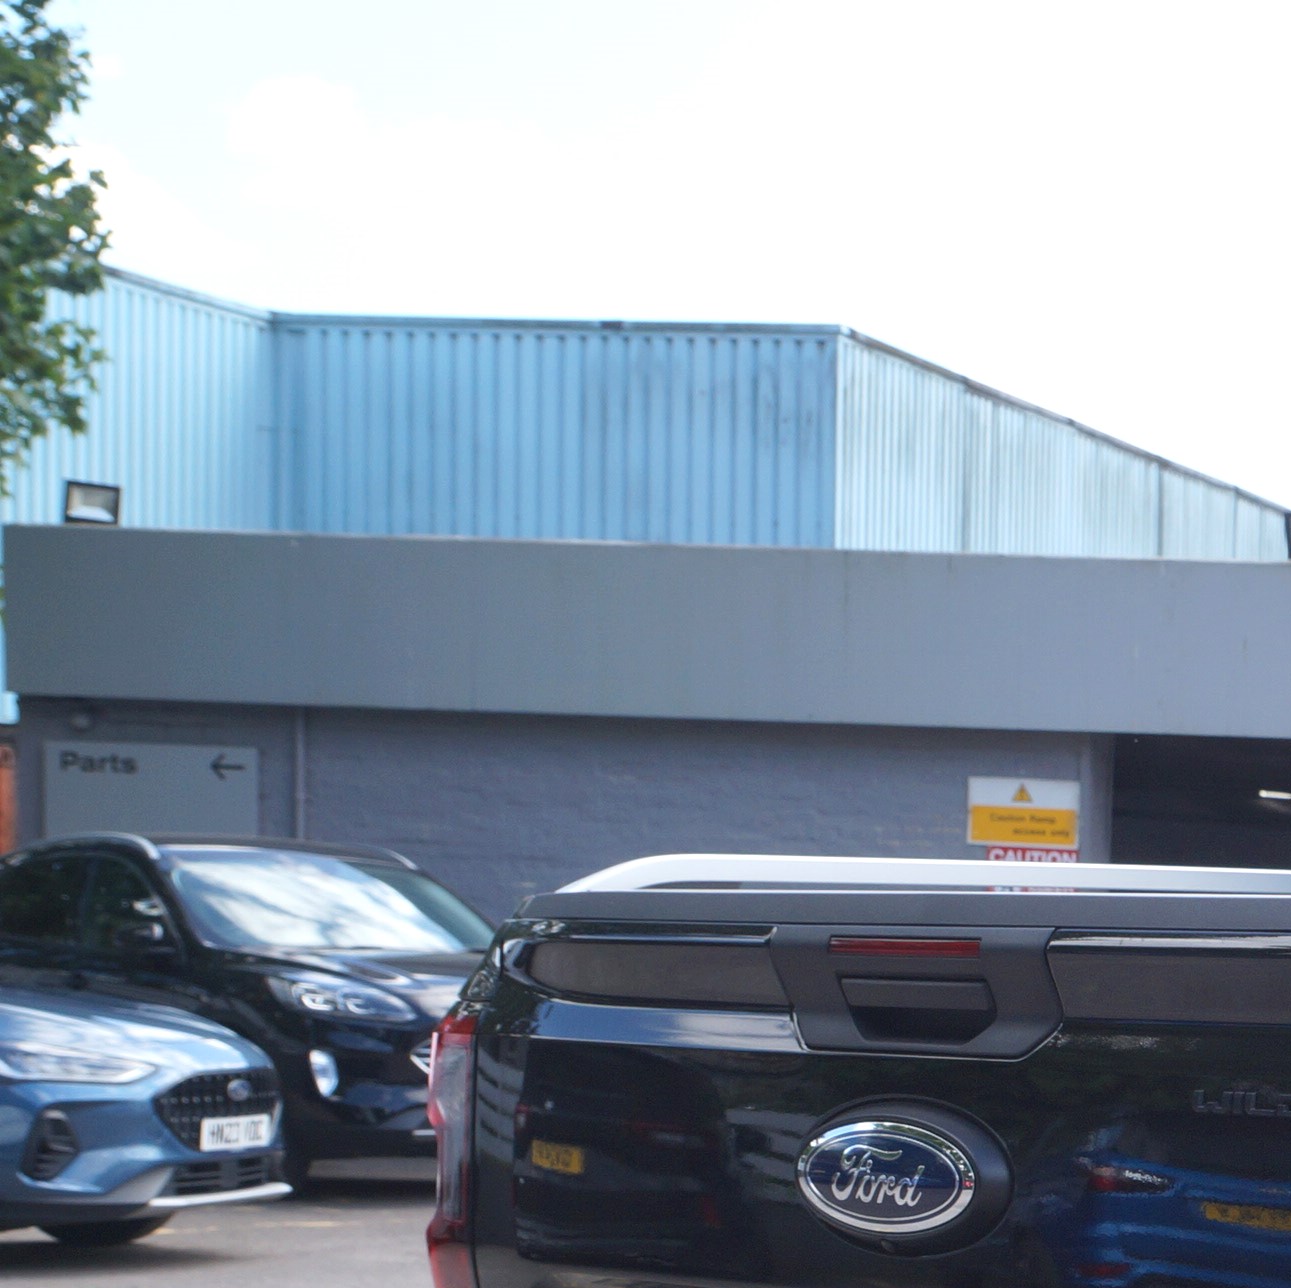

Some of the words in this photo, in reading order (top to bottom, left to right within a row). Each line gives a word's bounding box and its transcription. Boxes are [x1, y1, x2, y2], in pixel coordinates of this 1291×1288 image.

[60, 751, 138, 775] Parts
[988, 847, 1077, 863] CAUTION
[831, 1144, 926, 1207] Ford
